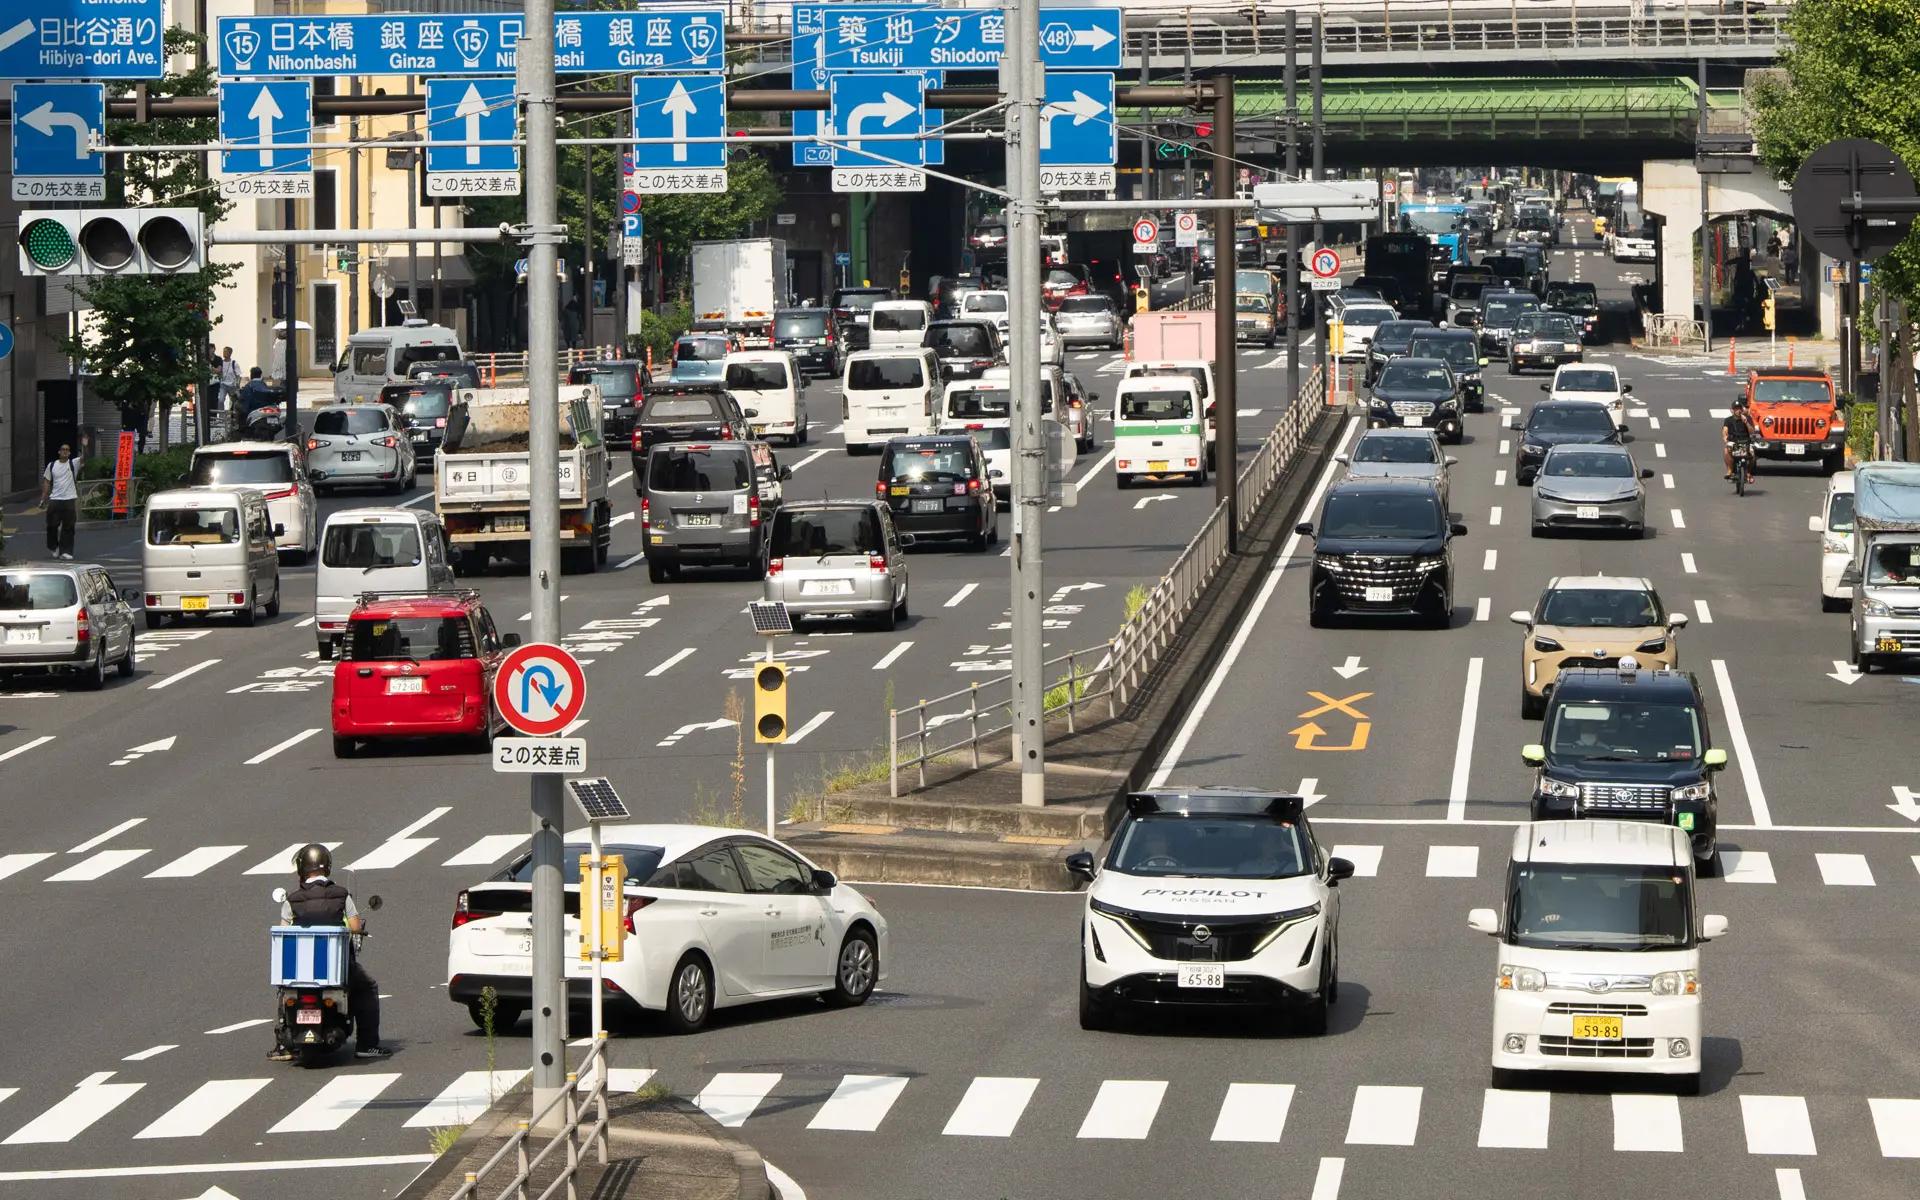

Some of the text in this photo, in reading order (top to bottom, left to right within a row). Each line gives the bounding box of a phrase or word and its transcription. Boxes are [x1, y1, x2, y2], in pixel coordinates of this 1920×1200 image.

[40, 18, 156, 46] 日比谷通り
[271, 20, 444, 51] 日本橋 銀座
[499, 17, 673, 48] 日橋 銀座
[838, 15, 914, 45] 築地
[1047, 30, 1070, 46] 481
[232, 35, 254, 55] 15
[461, 32, 482, 53] 15
[689, 30, 710, 49] 15
[39, 50, 158, 68] Hibiya-dori Ave.
[268, 53, 436, 70] Nihonbashi Ginza
[617, 50, 664, 66] Ginza
[851, 48, 904, 67] Tsukiji
[224, 179, 311, 195] この先交差点
[431, 176, 518, 193] この先交差点
[637, 174, 724, 189] この先交差点
[836, 172, 922, 188] この先交差点
[1041, 170, 1112, 187] の先交差点
[16, 181, 103, 198] この先交差点
[500, 745, 580, 766] この交差点
[1188, 974, 1221, 986] 65-88
[1584, 1025, 1619, 1038] 59-89
